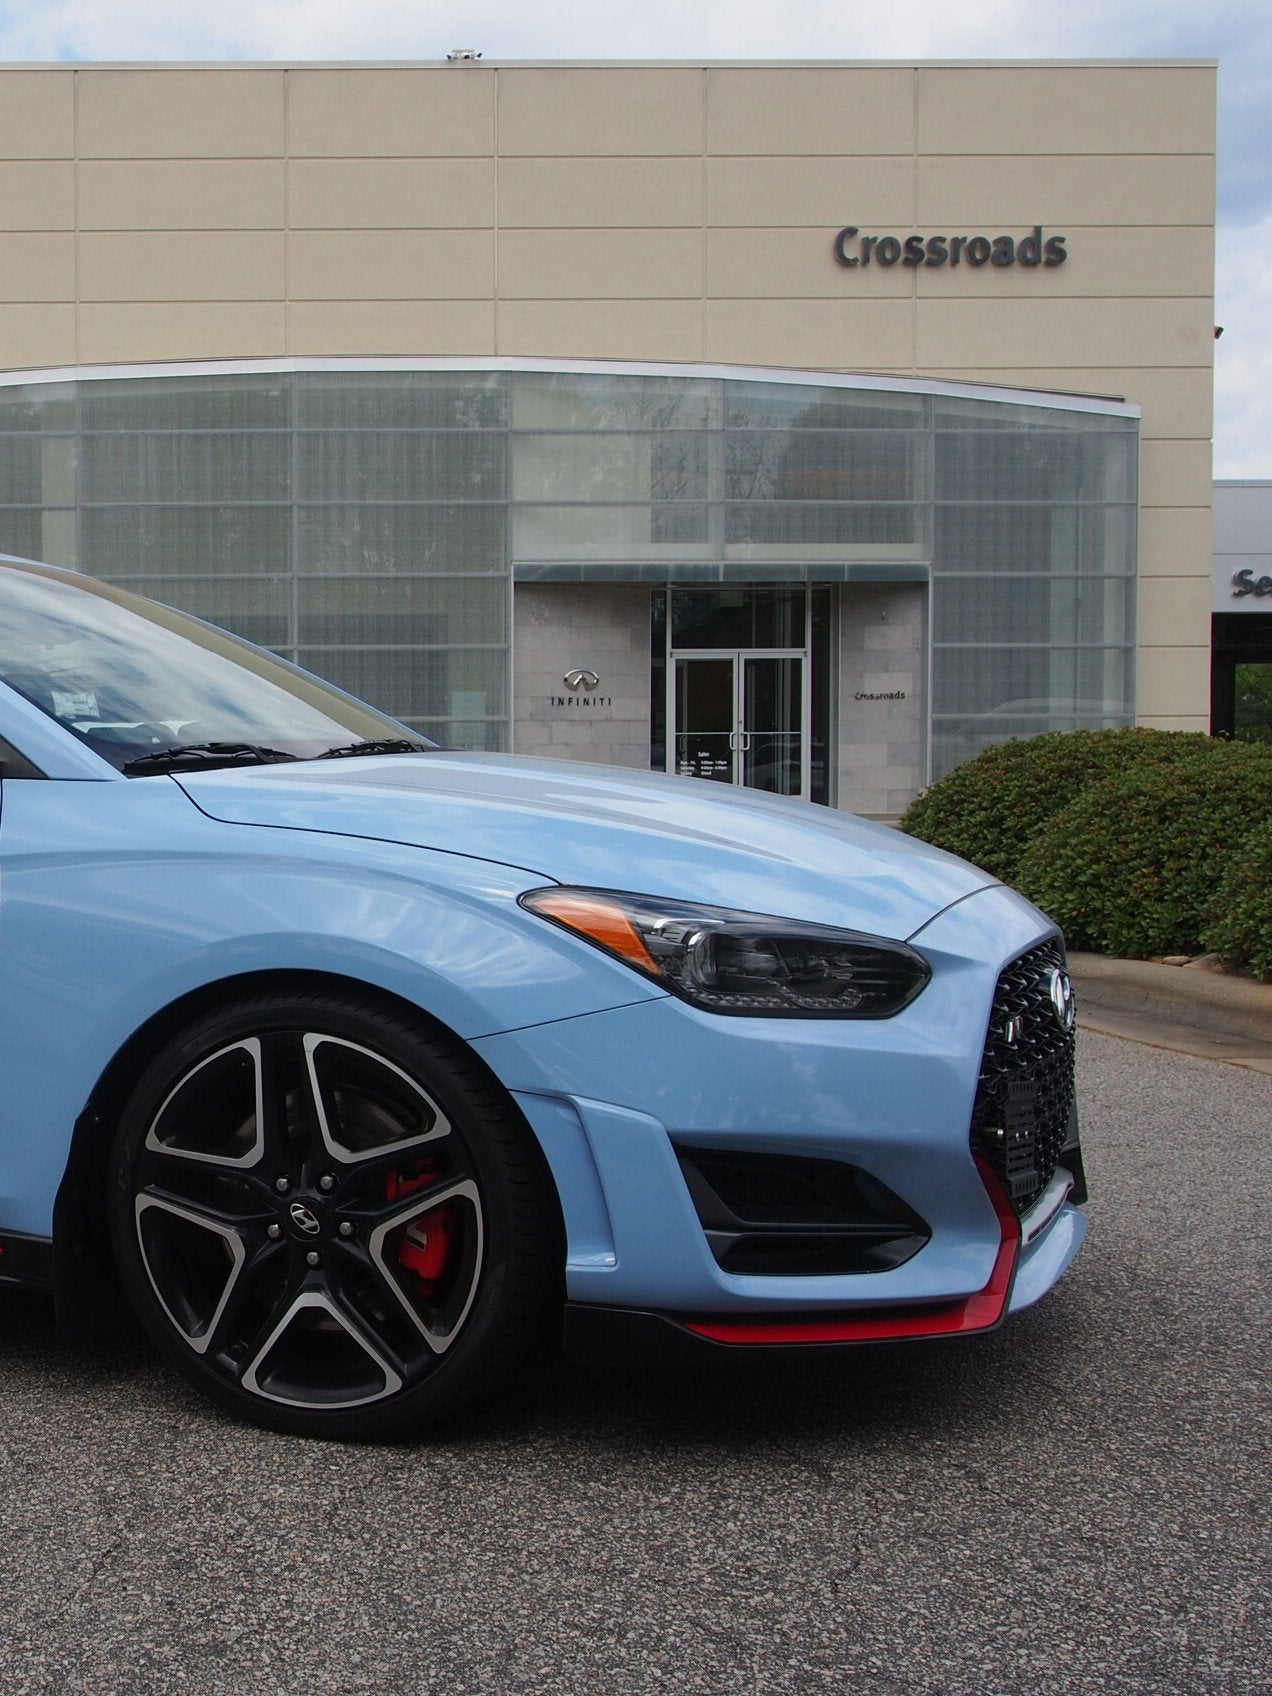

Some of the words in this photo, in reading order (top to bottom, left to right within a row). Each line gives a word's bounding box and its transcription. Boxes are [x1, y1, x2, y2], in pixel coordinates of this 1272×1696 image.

[834, 225, 1067, 267] Crossroads
[854, 690, 906, 701] Crossroads
[551, 697, 612, 706] INFINITI
